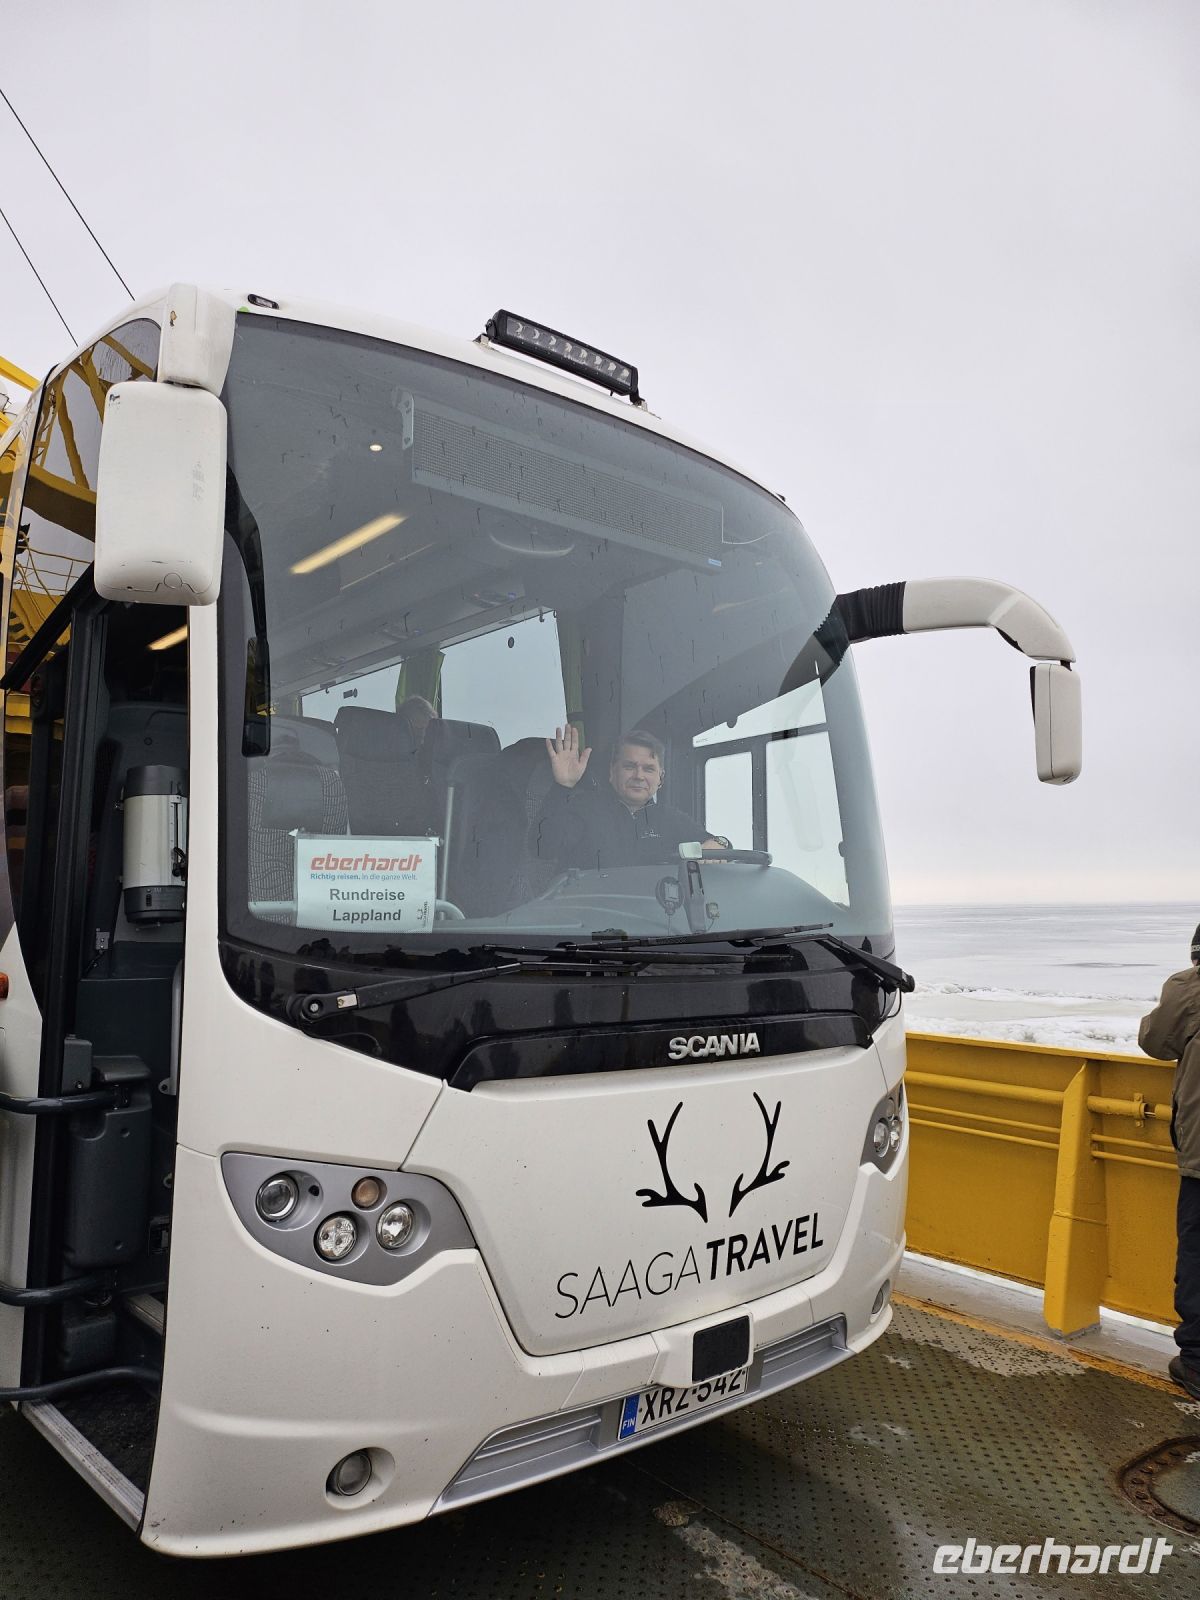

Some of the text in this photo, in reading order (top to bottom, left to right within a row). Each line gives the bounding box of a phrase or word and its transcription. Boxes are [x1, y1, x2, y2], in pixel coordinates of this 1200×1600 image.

[310, 854, 422, 872] eberhardt
[310, 873, 336, 882] Richtig
[329, 888, 405, 901] Rundreise
[332, 909, 402, 924] Lappland
[668, 1032, 761, 1060] SCANIA
[622, 1416, 636, 1430] FIN
